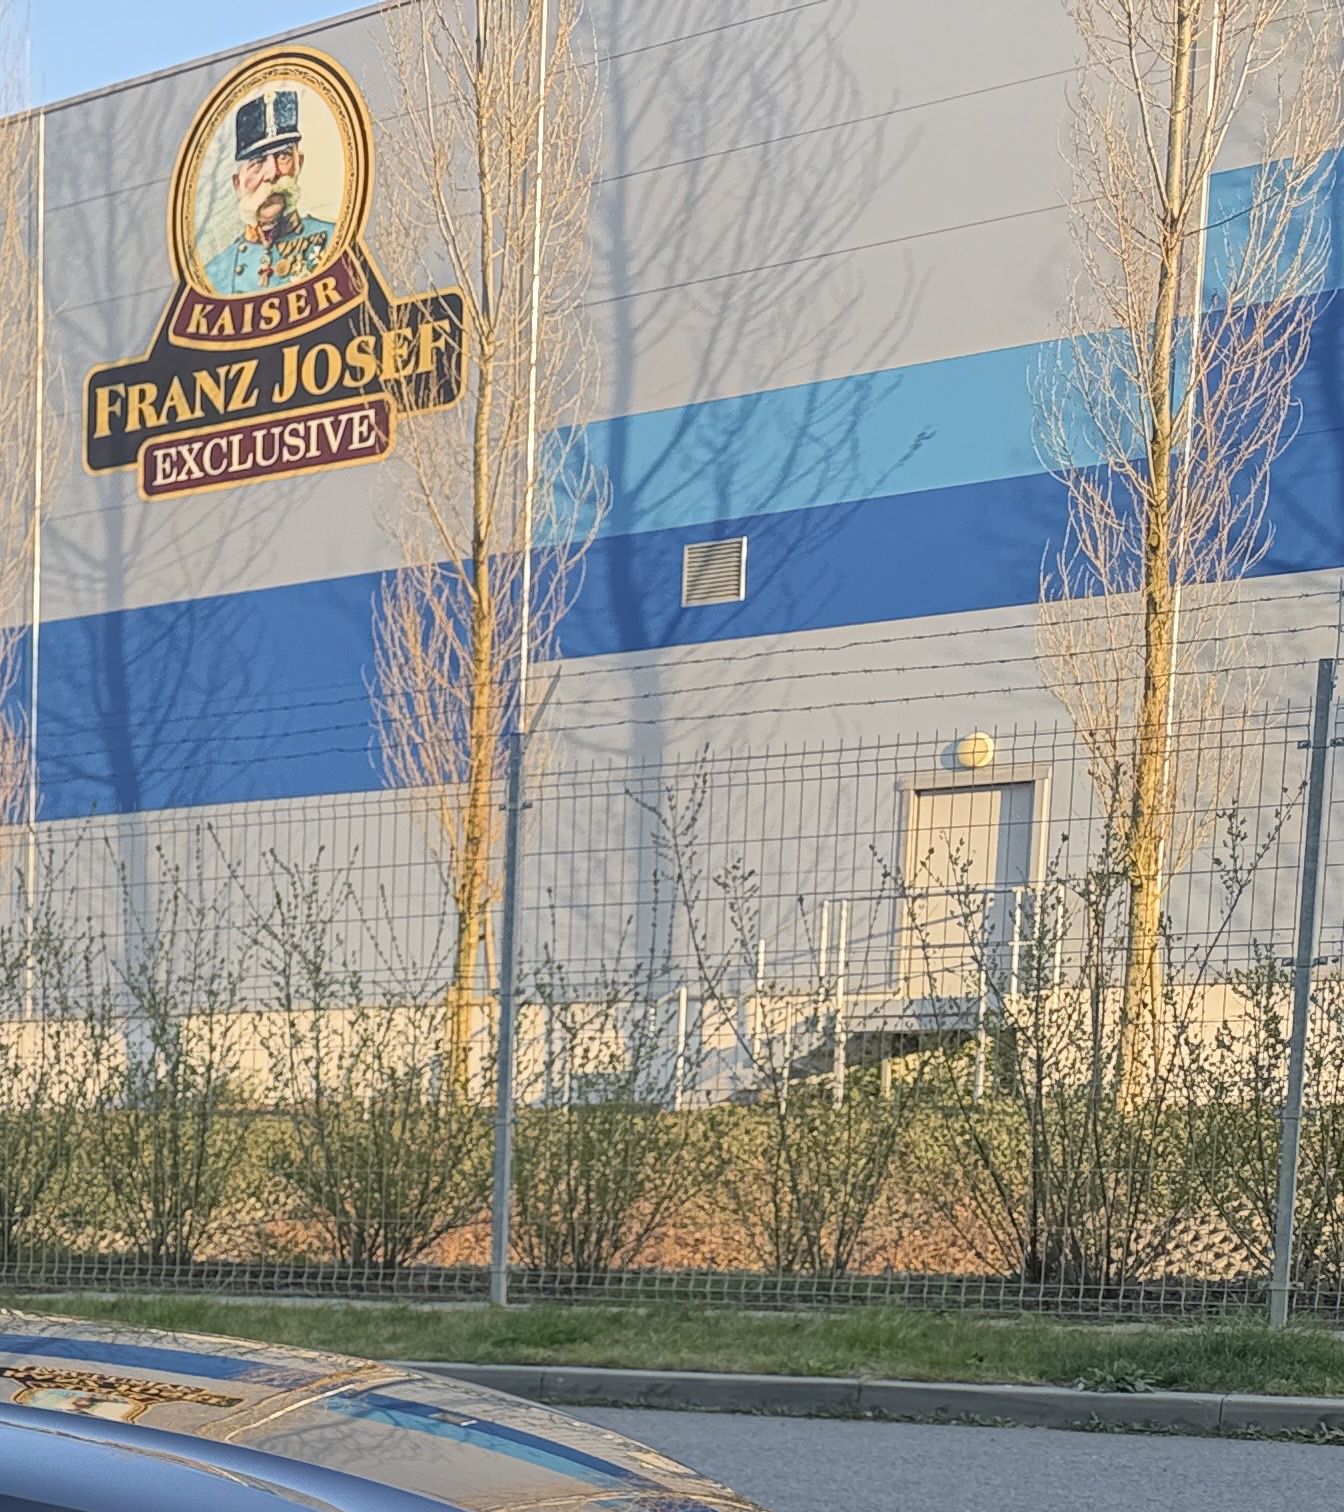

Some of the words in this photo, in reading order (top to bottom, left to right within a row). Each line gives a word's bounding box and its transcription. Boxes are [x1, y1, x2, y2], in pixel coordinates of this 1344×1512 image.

[186, 276, 344, 336] KAISER
[93, 359, 259, 439] FRANZ
[272, 319, 452, 403] JOSEF
[152, 408, 377, 487] EXCLUSIVE
